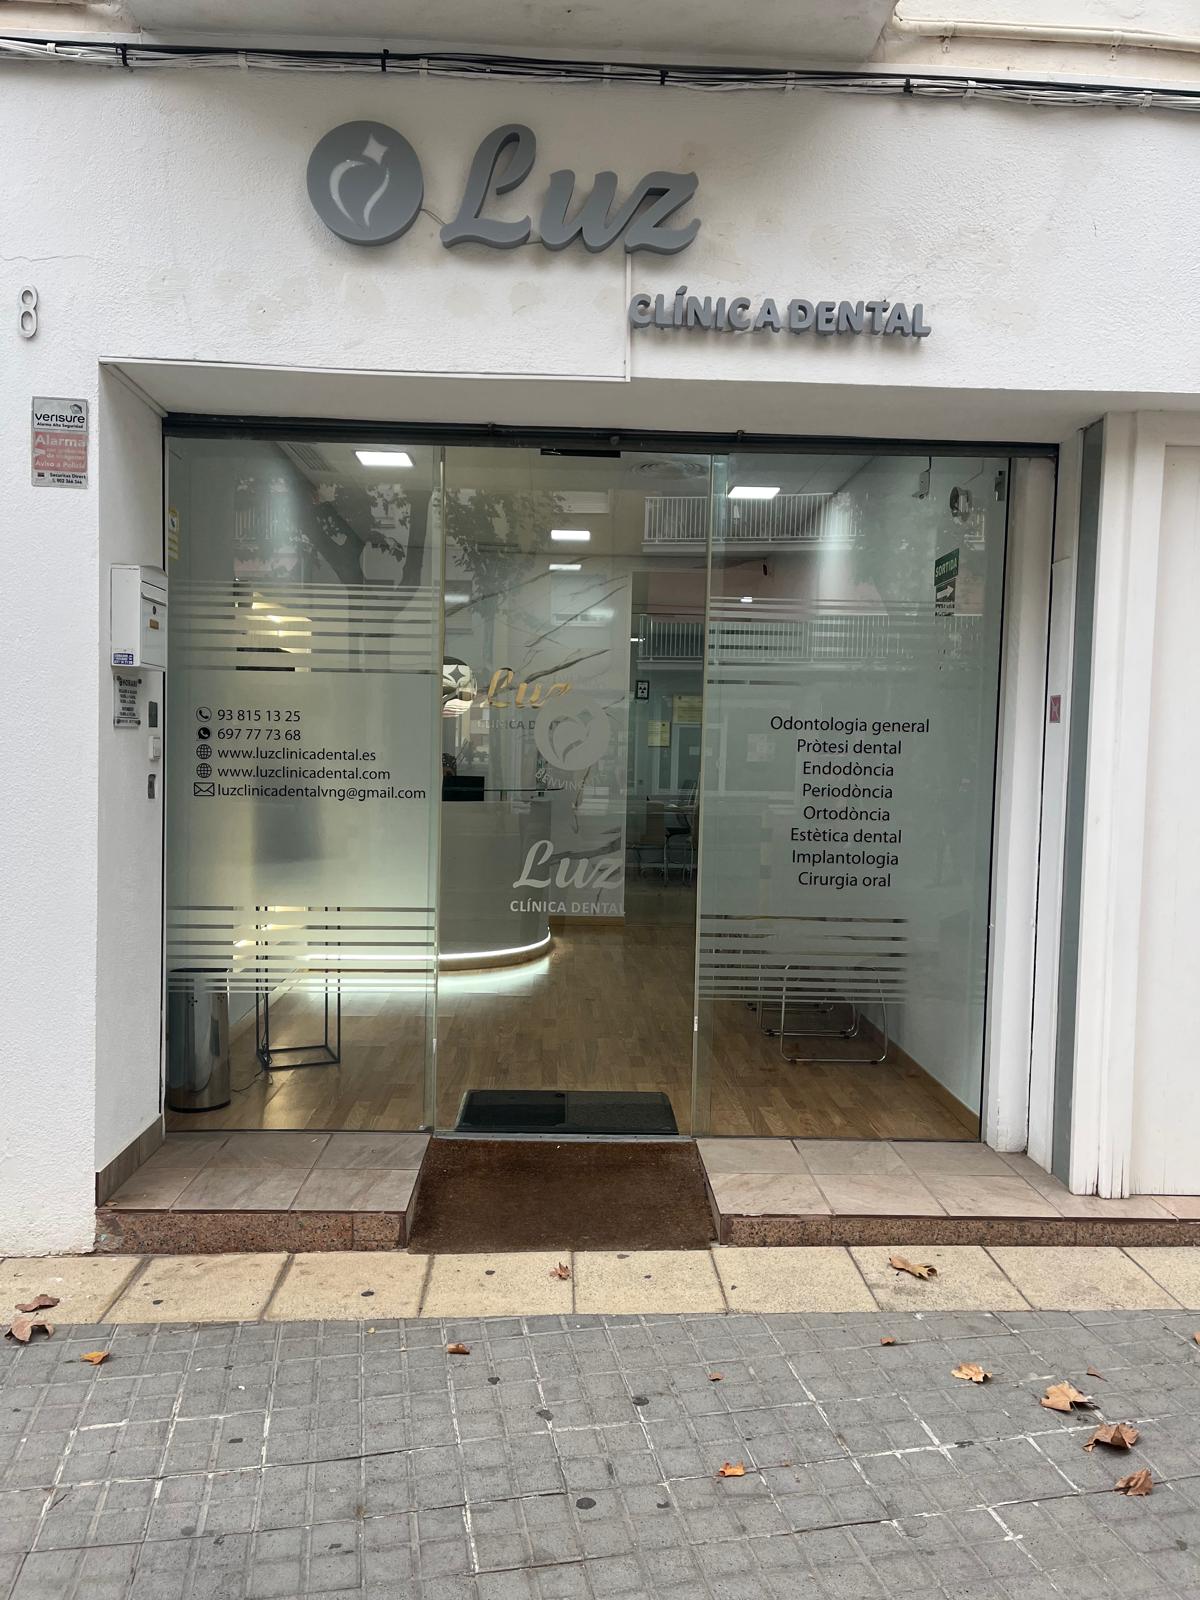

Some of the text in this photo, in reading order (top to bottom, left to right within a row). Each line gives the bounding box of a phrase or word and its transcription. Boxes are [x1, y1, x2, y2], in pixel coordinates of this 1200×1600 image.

[441, 123, 701, 256] Luz
[18, 284, 38, 339] 8
[629, 285, 932, 338] CLÍNICA DENTAL
[34, 413, 86, 424] verisure
[34, 434, 86, 447] Alarma
[935, 557, 958, 577] SORTIDA
[217, 709, 301, 722] 93 815 13 25
[770, 715, 930, 735] Odontologia general
[217, 728, 301, 741] 697 77 73 68
[217, 746, 377, 762] www.luzclinicadental.es
[797, 739, 902, 755] Pròtesi dental
[217, 765, 391, 780] www.luzclinicadental.com
[803, 761, 894, 777] Endodòncia
[217, 784, 426, 802] luzclinicadentalvng@gmail.com
[802, 783, 893, 799] Periodòncia
[803, 806, 890, 821] Ortodòncia
[791, 828, 902, 844] Estètica dental
[512, 839, 624, 889] Luz
[792, 850, 899, 868] Implantologia
[798, 872, 891, 890] Cirurgia oral
[510, 897, 625, 914] CLÍNICA DENTAL
